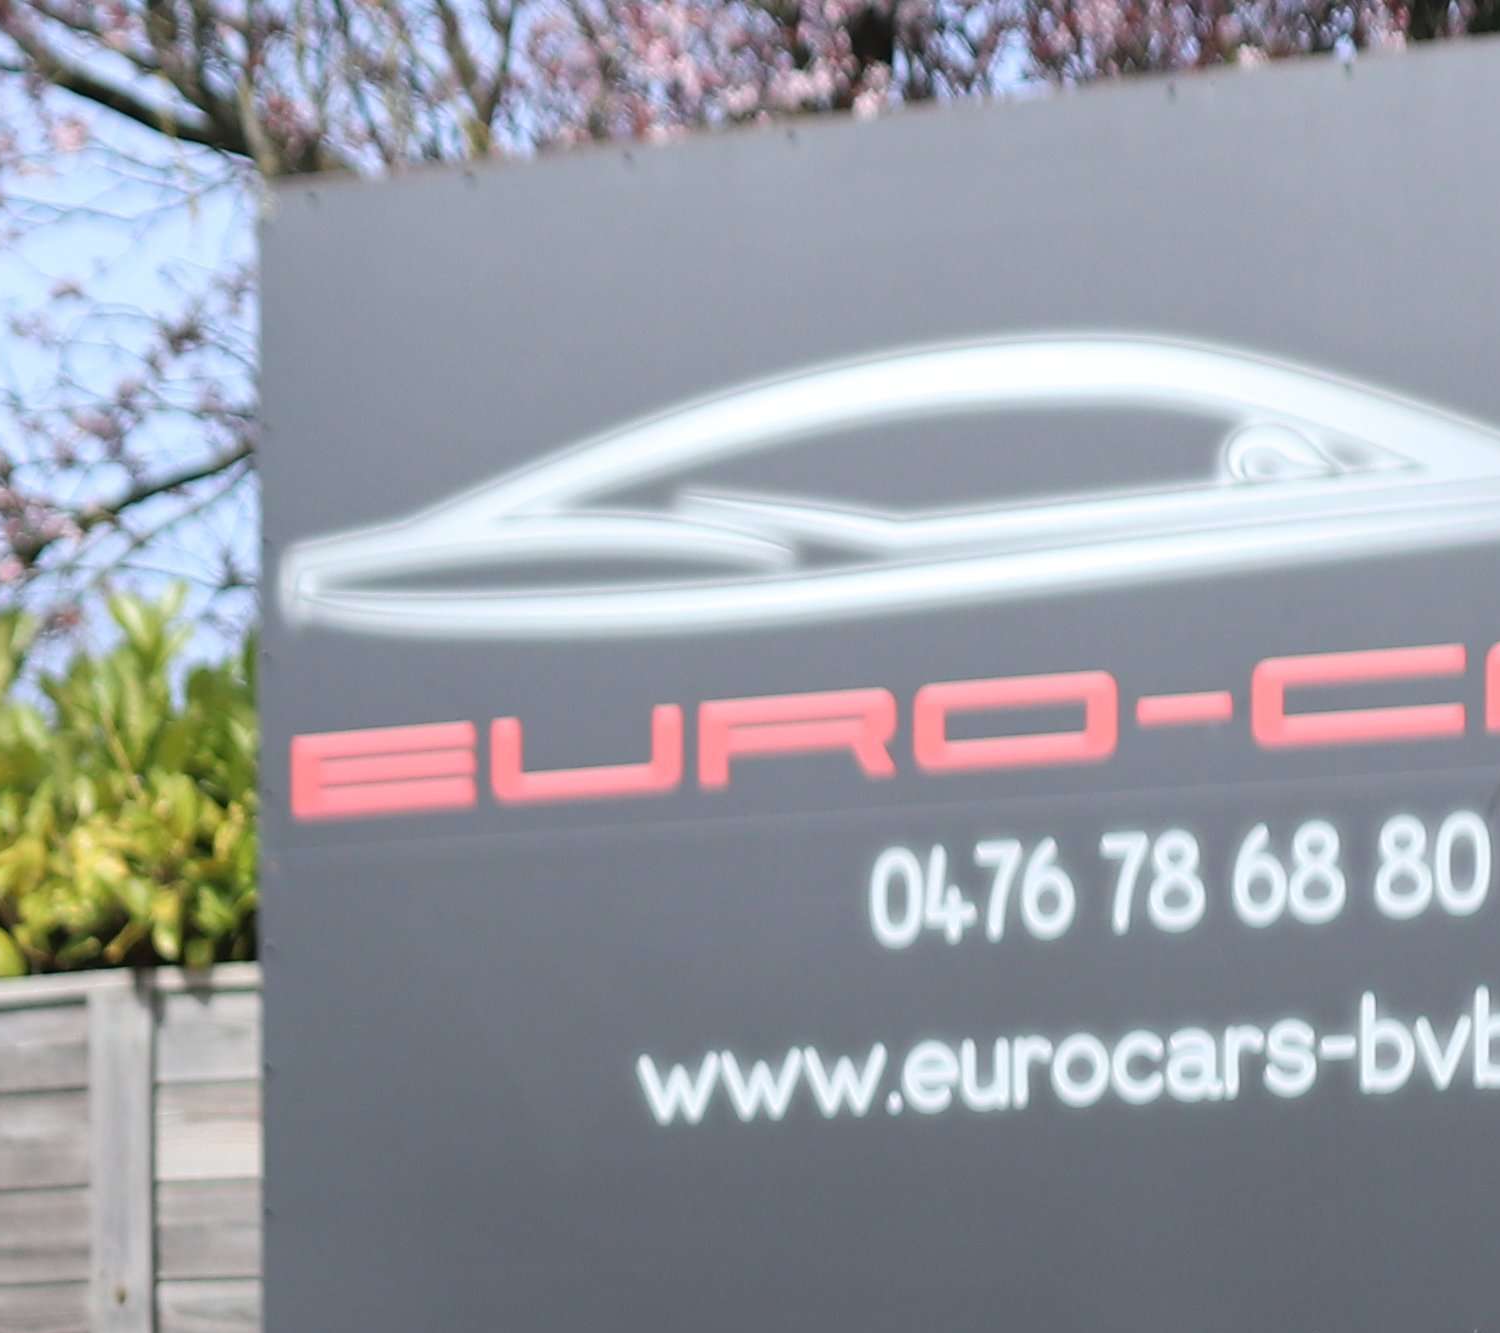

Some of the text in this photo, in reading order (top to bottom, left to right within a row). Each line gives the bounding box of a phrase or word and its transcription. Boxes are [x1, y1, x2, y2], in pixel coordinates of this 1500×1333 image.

[866, 806, 1494, 952] 0476 78 68 80
